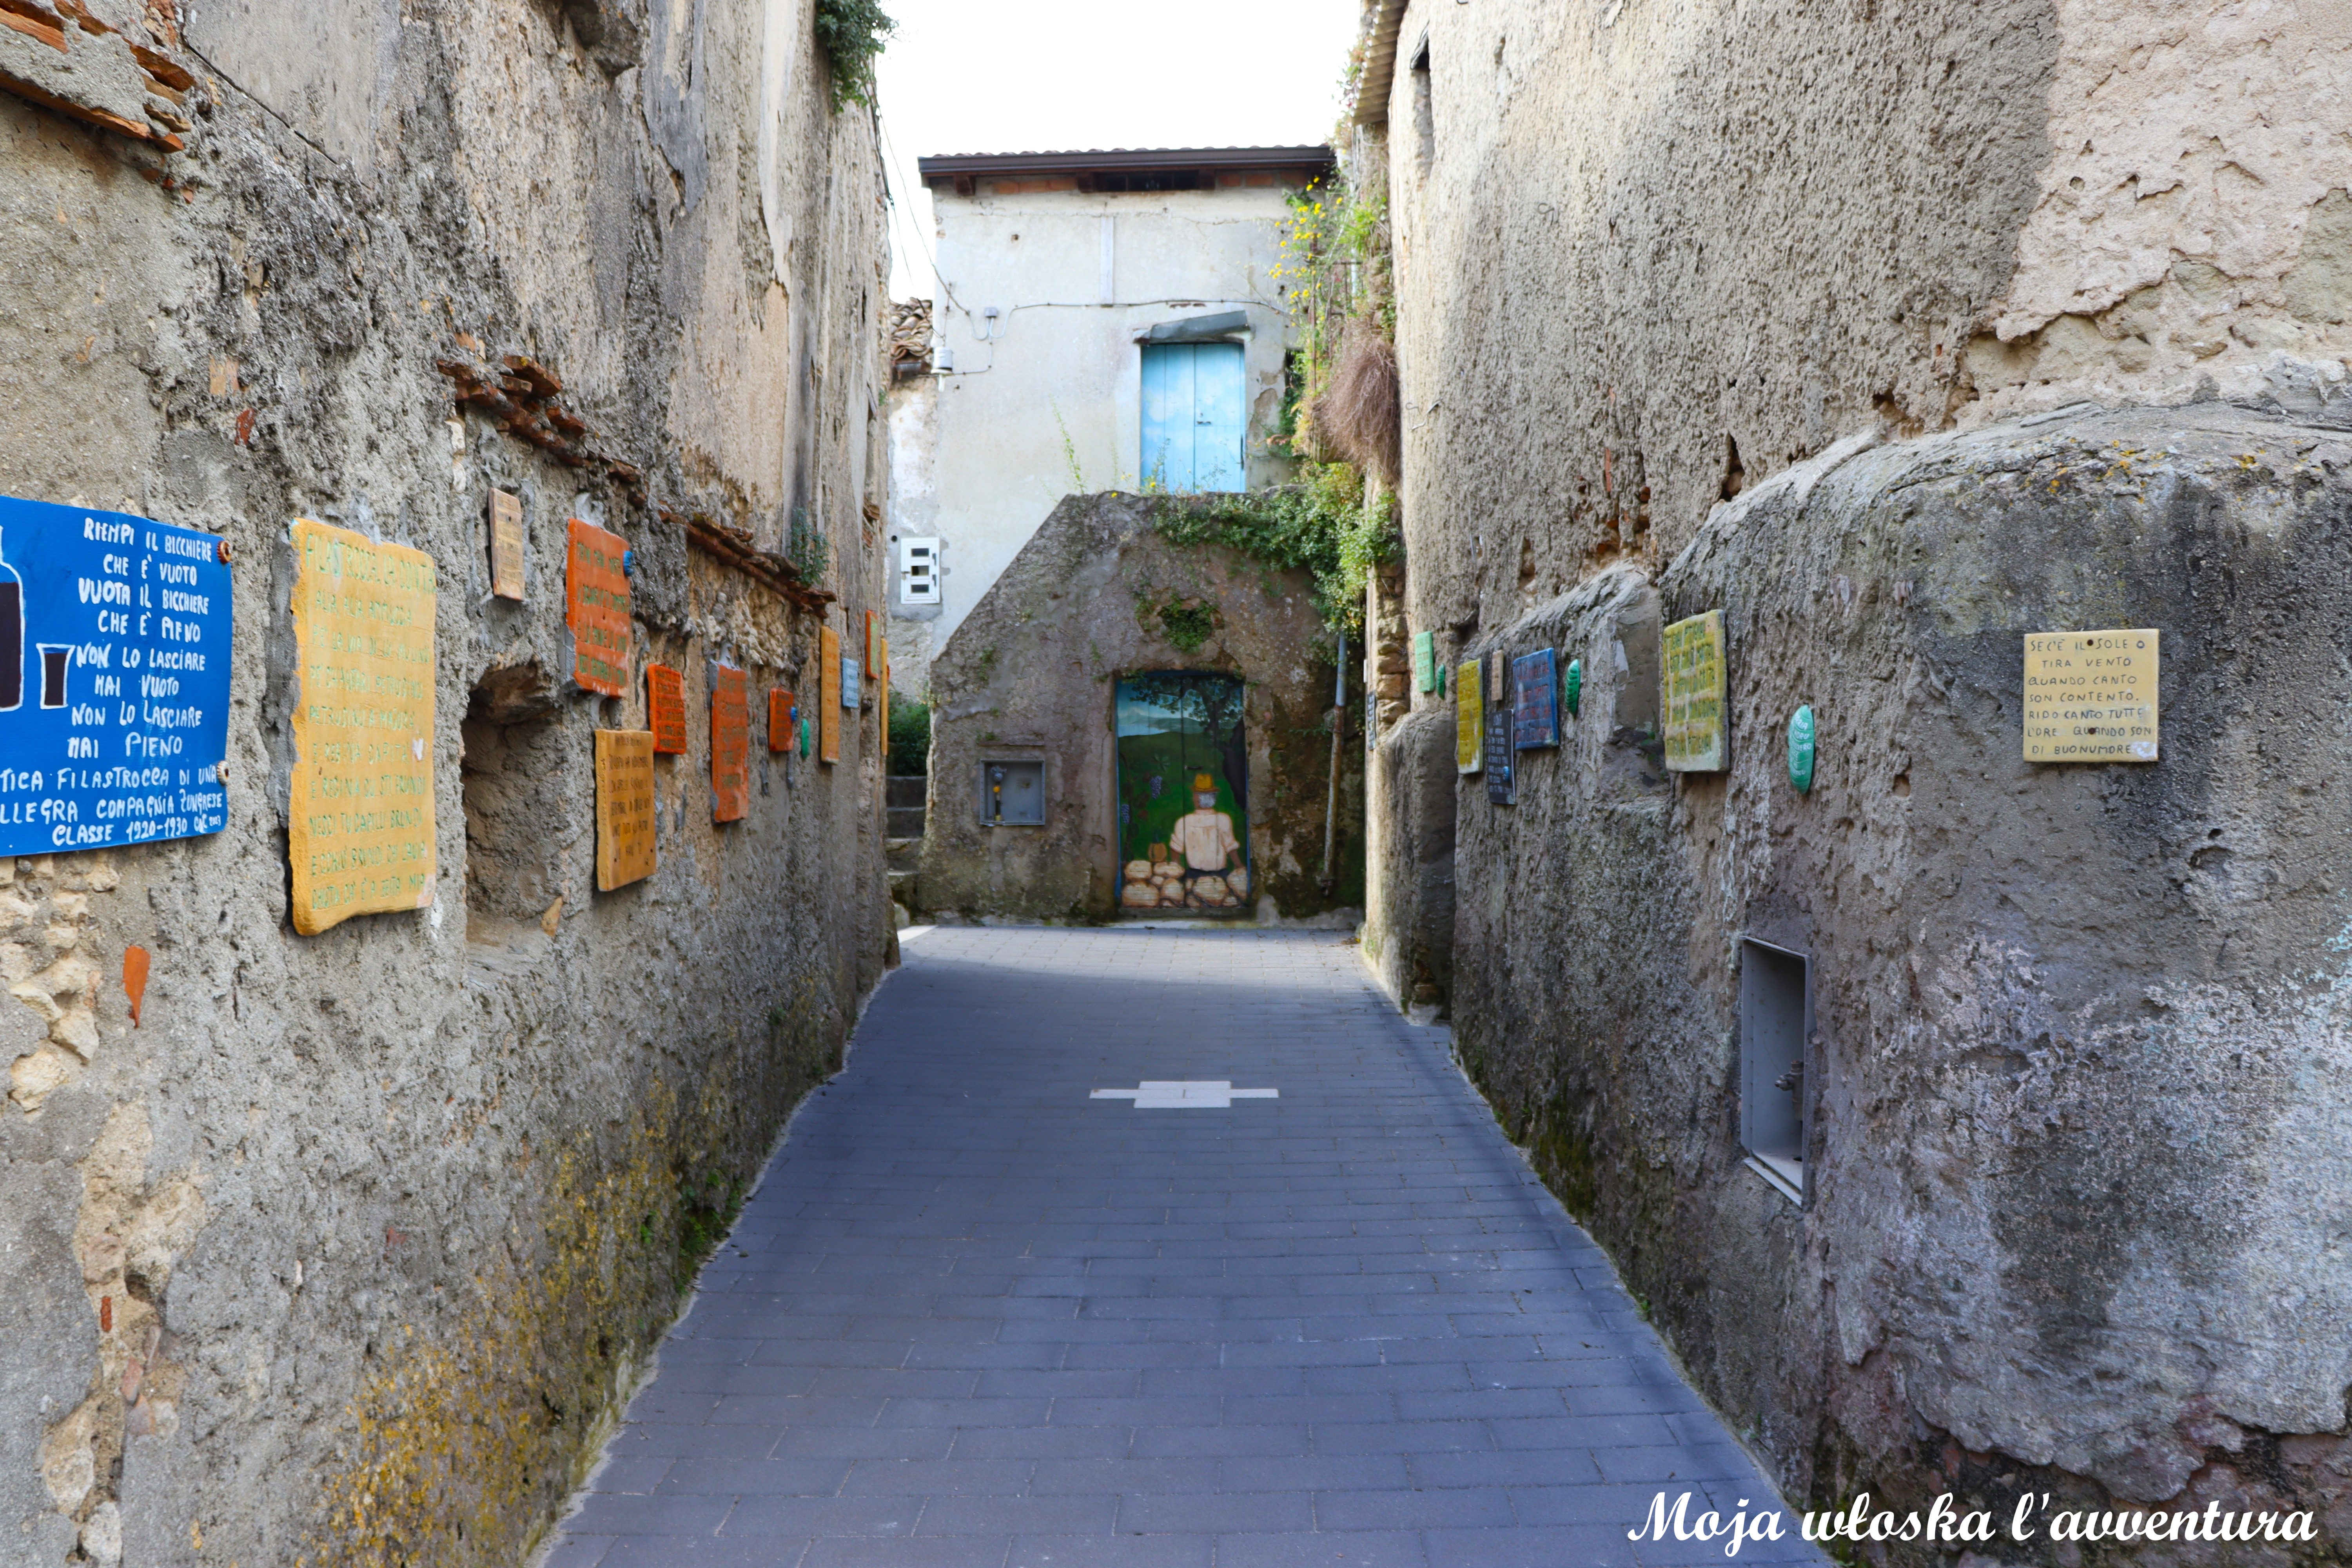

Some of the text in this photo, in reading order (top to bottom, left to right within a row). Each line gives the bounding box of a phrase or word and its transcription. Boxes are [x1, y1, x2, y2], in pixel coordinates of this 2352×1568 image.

[83, 517, 212, 563] RIEMPI IL BICCHIERE
[103, 554, 129, 577] CHE
[160, 562, 198, 586] VUOTO
[78, 577, 209, 615] VUOTA IL BICCHIERE
[98, 609, 129, 635] CHE
[162, 616, 201, 643] PIENO
[76, 641, 112, 669] NON
[122, 646, 141, 668] LO
[2075, 642, 2085, 651] IL
[2096, 638, 2128, 649] SOLE
[2042, 657, 2131, 668] TIRA VENTO
[94, 674, 180, 697] MAI VUOTO
[2028, 675, 2137, 686] QUANDO CANTO
[2029, 691, 2139, 702] SON CONTENTO.
[72, 700, 202, 728] NON LO LASCIARE
[2029, 708, 2143, 719] RIDO CANTO TUTTE
[2028, 726, 2151, 737] L'ORE QUANDO SON
[67, 731, 182, 759] MAI PIENO
[2032, 745, 2043, 754] DI
[57, 766, 169, 790] FILASTROCCA
[179, 769, 190, 785] DI
[198, 764, 216, 785] UNA
[51, 824, 114, 846] CLASSE
[126, 817, 188, 842] 1920-1930
